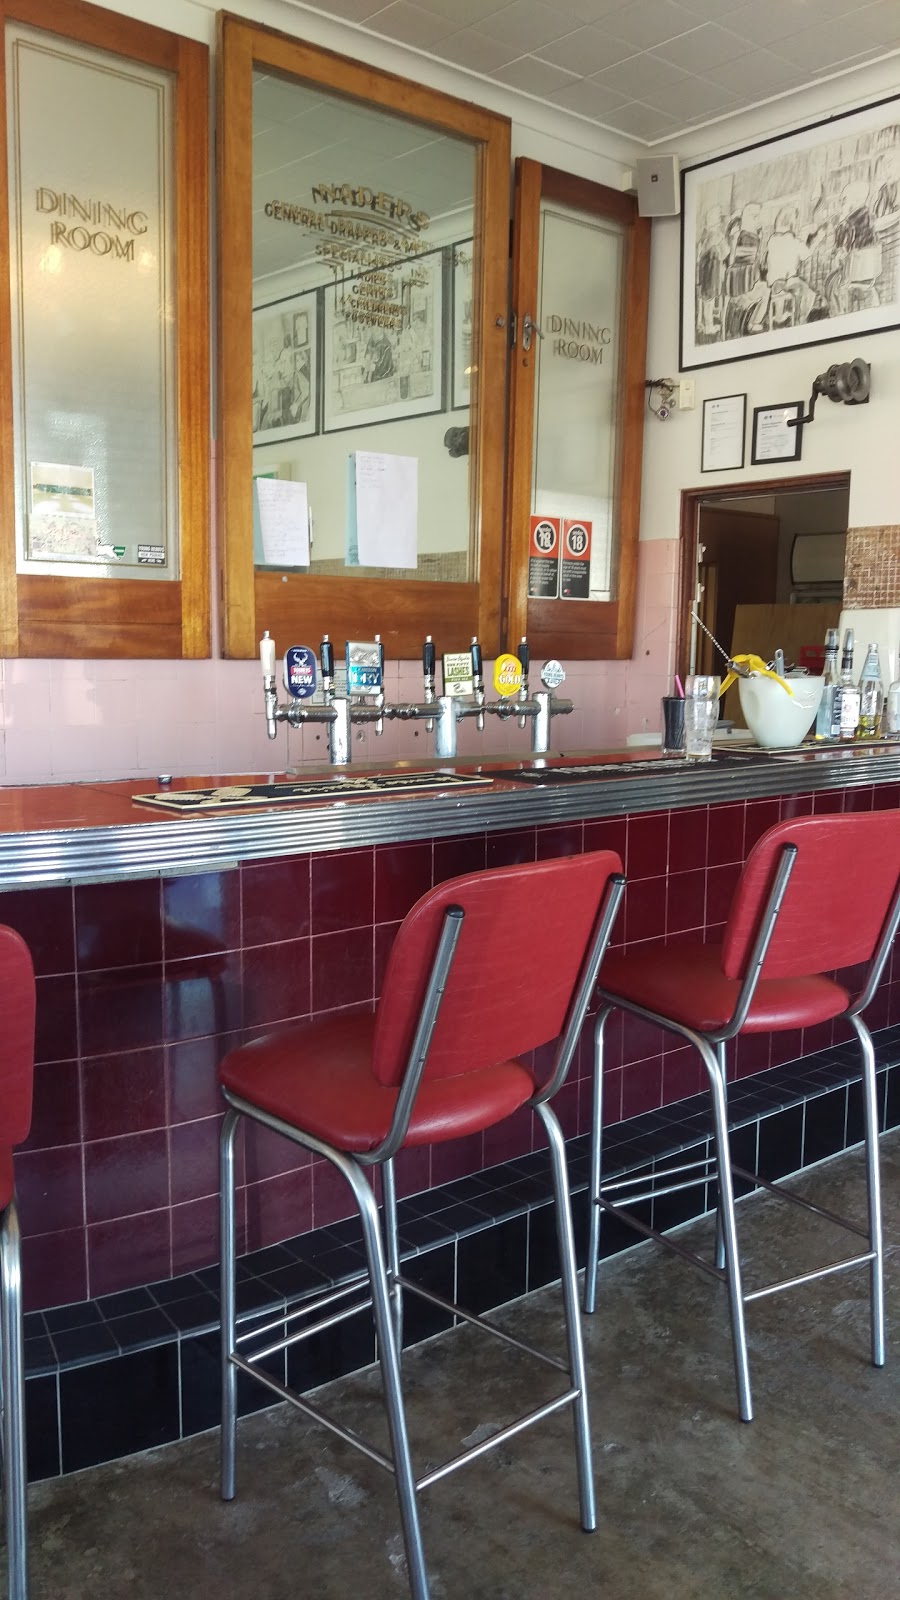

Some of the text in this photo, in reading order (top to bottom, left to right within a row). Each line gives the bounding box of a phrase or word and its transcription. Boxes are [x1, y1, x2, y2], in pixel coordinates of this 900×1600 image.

[36, 187, 148, 235] DINING
[50, 221, 135, 262] ROOM
[547, 314, 611, 345] DINING
[553, 338, 603, 365] ROOM
[571, 535, 583, 551] 18
[291, 675, 313, 684] NEW
[447, 667, 470, 677] LASHES
[498, 673, 521, 685] GOLD
